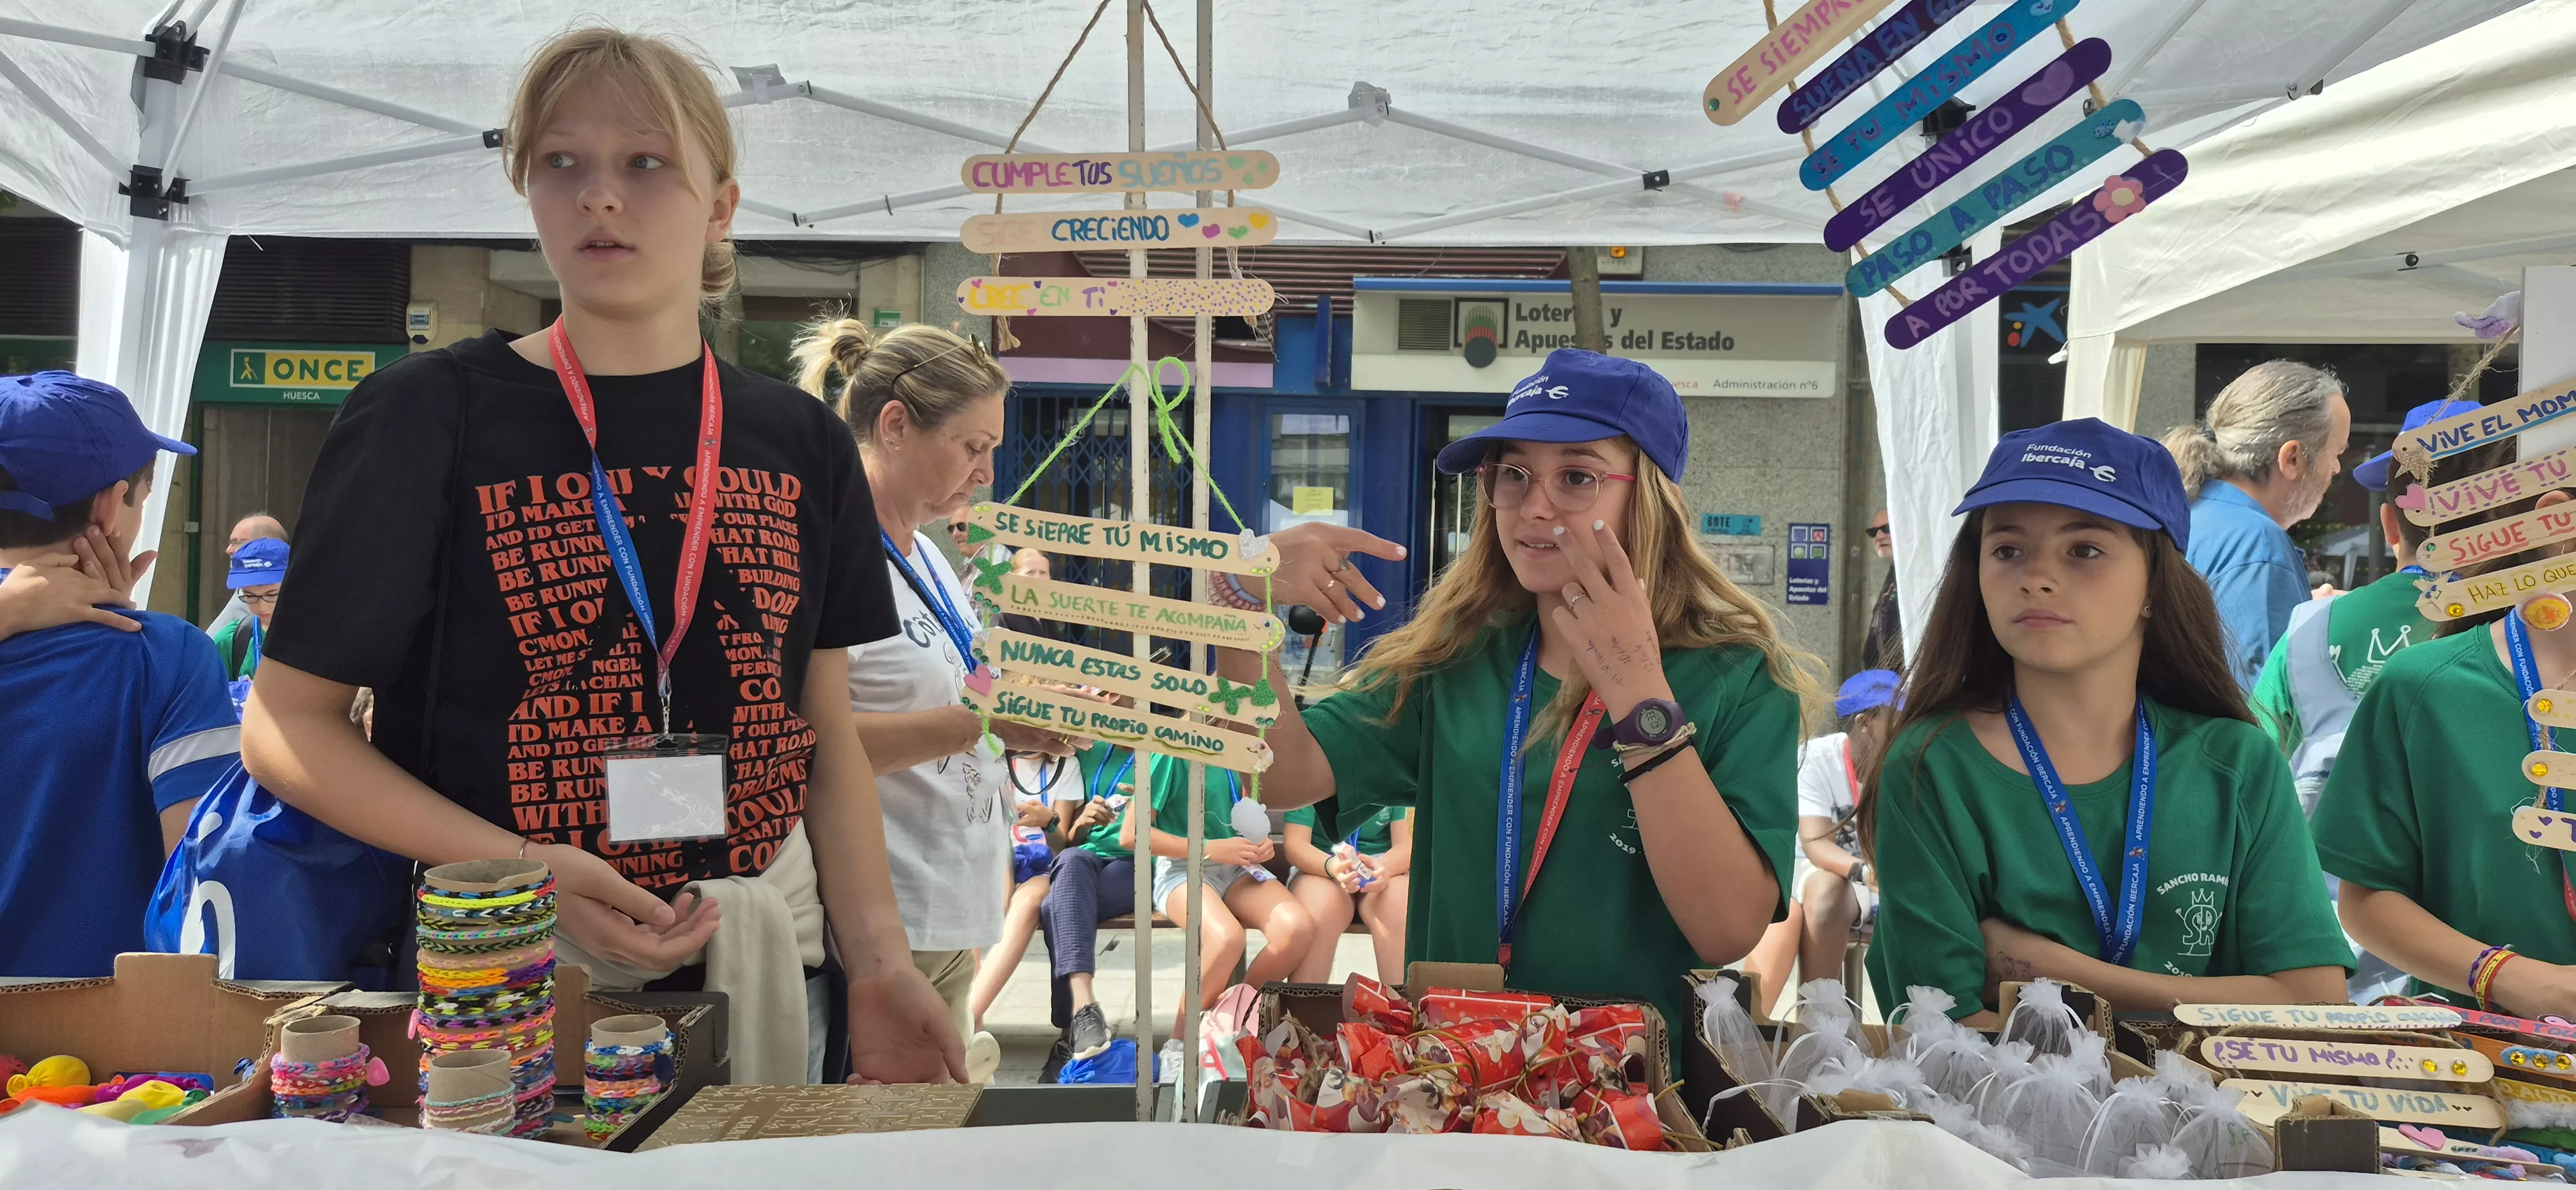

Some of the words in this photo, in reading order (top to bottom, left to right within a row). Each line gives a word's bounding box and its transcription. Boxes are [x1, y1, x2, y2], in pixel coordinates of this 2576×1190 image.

[1875, 11, 1920, 54] EN
[1727, 64, 1757, 104] SE
[1812, 146, 1843, 181] SE
[1844, 118, 1882, 151] TU
[972, 161, 1074, 187] CUMPLE
[1072, 160, 1113, 185] TUS
[1117, 153, 1222, 187] SUEÑOS
[1859, 185, 1895, 227] SE
[1860, 229, 1933, 289] PASO
[1949, 205, 1976, 234] A
[1983, 144, 2074, 211] PASO
[1905, 314, 1930, 339] A
[1935, 276, 1988, 317] POR
[1984, 205, 2101, 286] TODAS
[969, 284, 1029, 310] CREE
[1039, 285, 1072, 307] EN
[1610, 307, 1622, 327] y
[1515, 329, 1613, 354] Apuess
[1620, 329, 1653, 350] del
[1661, 331, 1735, 352] Estado
[273, 358, 365, 381] ONCE
[1713, 378, 1796, 390] Administración
[283, 391, 320, 400] HUESCA
[571, 375, 589, 420] APRENDIENDO
[2481, 415, 2512, 436] EL
[2517, 390, 2576, 423] MOM
[2022, 453, 2085, 469] Ibercaja
[2026, 444, 2092, 459] Fundación
[701, 450, 712, 499] APRENDIENDO
[2527, 459, 2567, 481] TU
[475, 480, 516, 514] IF
[526, 475, 547, 504] I
[486, 510, 515, 532] I'D
[764, 495, 797, 518] GOD
[691, 506, 705, 552] EMPRENDER
[994, 512, 1020, 534] SE
[1103, 522, 1130, 547] TÚ
[2537, 512, 2571, 531] TU
[486, 530, 524, 551] AND
[527, 525, 552, 540] I'D
[556, 519, 595, 535] GET
[723, 513, 757, 525] OUR
[759, 515, 798, 536] PLACES
[491, 547, 526, 571] BE
[758, 529, 800, 554] ROAD
[497, 567, 534, 592] BE
[772, 549, 800, 572] HILL
[600, 498, 623, 547] EMPRENDER
[619, 547, 629, 565] CON
[625, 565, 645, 612] FUNDACIÓN
[688, 552, 696, 569] CON
[504, 592, 537, 612] BE
[737, 569, 800, 592] BUILDING
[681, 571, 694, 616] FUNDACIÓN
[2468, 583, 2509, 603] HAZ
[2514, 575, 2536, 591] LO
[2544, 564, 2576, 583] QUE
[507, 611, 542, 638] IF
[547, 607, 567, 629] I
[1010, 584, 1039, 607] LA
[1048, 590, 1119, 617] SUERTE
[1125, 602, 1150, 619] TE
[1154, 607, 1247, 633] ACOMPAÑA
[524, 656, 554, 672] LET
[1000, 640, 1075, 669] NUNCA
[1080, 657, 1142, 681] ESTAS
[1150, 672, 1208, 696] SOLO
[2515, 644, 2524, 657] CON
[1519, 661, 1528, 692] IBERCAJA
[2518, 658, 2534, 697] FUNDACIÓN
[508, 695, 580, 721] AND
[588, 692, 621, 714] IF
[630, 692, 643, 713] I
[1059, 706, 1087, 726] TU
[507, 743, 550, 759] AND
[554, 741, 578, 755] I'D
[775, 729, 817, 754] ROAD
[508, 724, 541, 742] I'D
[548, 717, 626, 740] MAKE
[633, 715, 653, 732] A
[748, 722, 781, 737] OUR
[1510, 706, 1522, 757] APRENDIENDO
[1563, 719, 1590, 771] APRENDIENDO
[507, 761, 545, 781] BE
[2010, 708, 2020, 724] CON
[2016, 722, 2040, 764] FUNDACIÓN
[2035, 762, 2058, 800] IBERCAJA
[2142, 731, 2150, 776] EMPRENDER
[511, 783, 549, 804] BE
[1506, 765, 1515, 815] EMPRENDER
[1546, 780, 1564, 827] EMPRENDER
[512, 800, 607, 830] WITH
[2136, 783, 2149, 842] APRENDIENDO
[1540, 827, 1549, 845] CON
[1609, 832, 1636, 855] 2019
[1504, 836, 1512, 884] FUNDACIÓN
[2060, 817, 2089, 874] APRENDIENDO
[2088, 882, 2111, 933] EMPRENDER
[2157, 873, 2199, 895] SANCHO
[2201, 873, 2229, 887] RAMÍ
[2119, 902, 2136, 951] FUNDACIÓN
[2130, 863, 2140, 902] IBERCAJA
[2285, 1009, 2317, 1023] TU
[2479, 1014, 2521, 1028] POR
[2259, 1044, 2298, 1062] TU
[2339, 1090, 2379, 1110] TU
